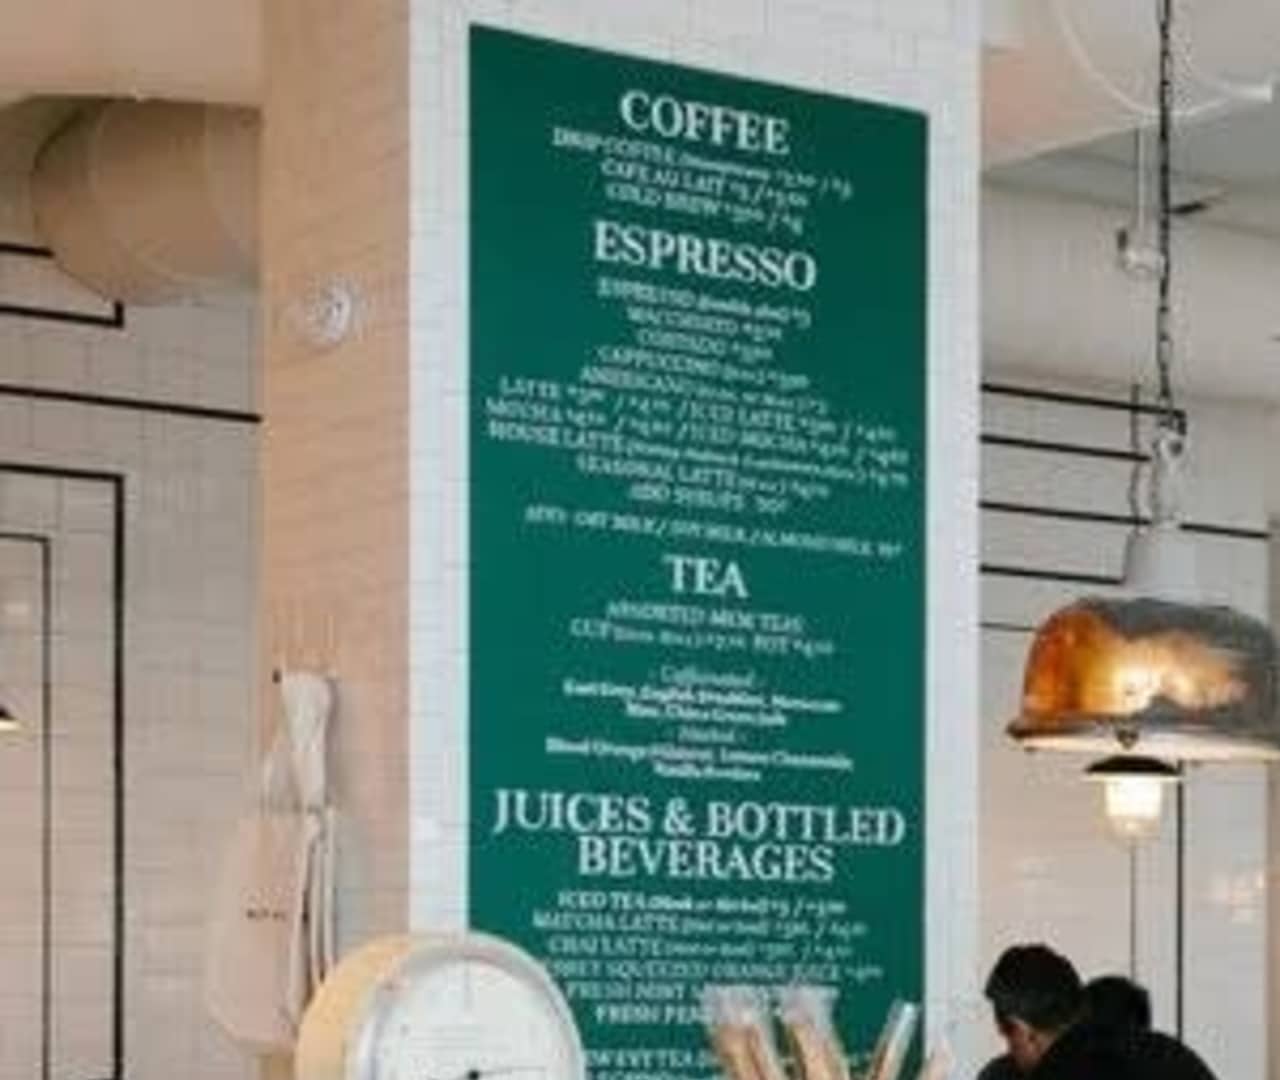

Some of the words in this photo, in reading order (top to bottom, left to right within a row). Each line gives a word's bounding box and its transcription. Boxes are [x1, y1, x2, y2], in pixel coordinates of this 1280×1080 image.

[621, 88, 789, 158] COFFEE
[663, 189, 721, 219] BREW
[596, 219, 815, 292] ESPRESSO
[597, 276, 696, 309] ESPRESSO
[627, 304, 738, 336] MACCHIATO
[637, 327, 727, 357] CORTADO
[500, 375, 558, 400] LATTE
[738, 406, 794, 430] LATTE
[486, 396, 563, 424] MOCHA
[741, 427, 807, 453] MOCHA
[489, 419, 559, 445] HOUSE
[563, 428, 624, 453] LATTE
[575, 453, 674, 482] SEASONAL
[677, 464, 737, 489] LATTE
[662, 555, 748, 598] TEA
[493, 789, 651, 834] JUICES
[663, 798, 695, 836] &
[707, 801, 906, 846] BOTTLED
[578, 836, 835, 881] BEVERAGES
[558, 891, 607, 909] ICED
[610, 892, 645, 910] TEA
[532, 909, 615, 929] MATCHA
[617, 911, 679, 931] LATTE
[550, 934, 598, 953] CHAI
[601, 936, 662, 956] LATTE
[596, 1004, 658, 1024] FRESH
